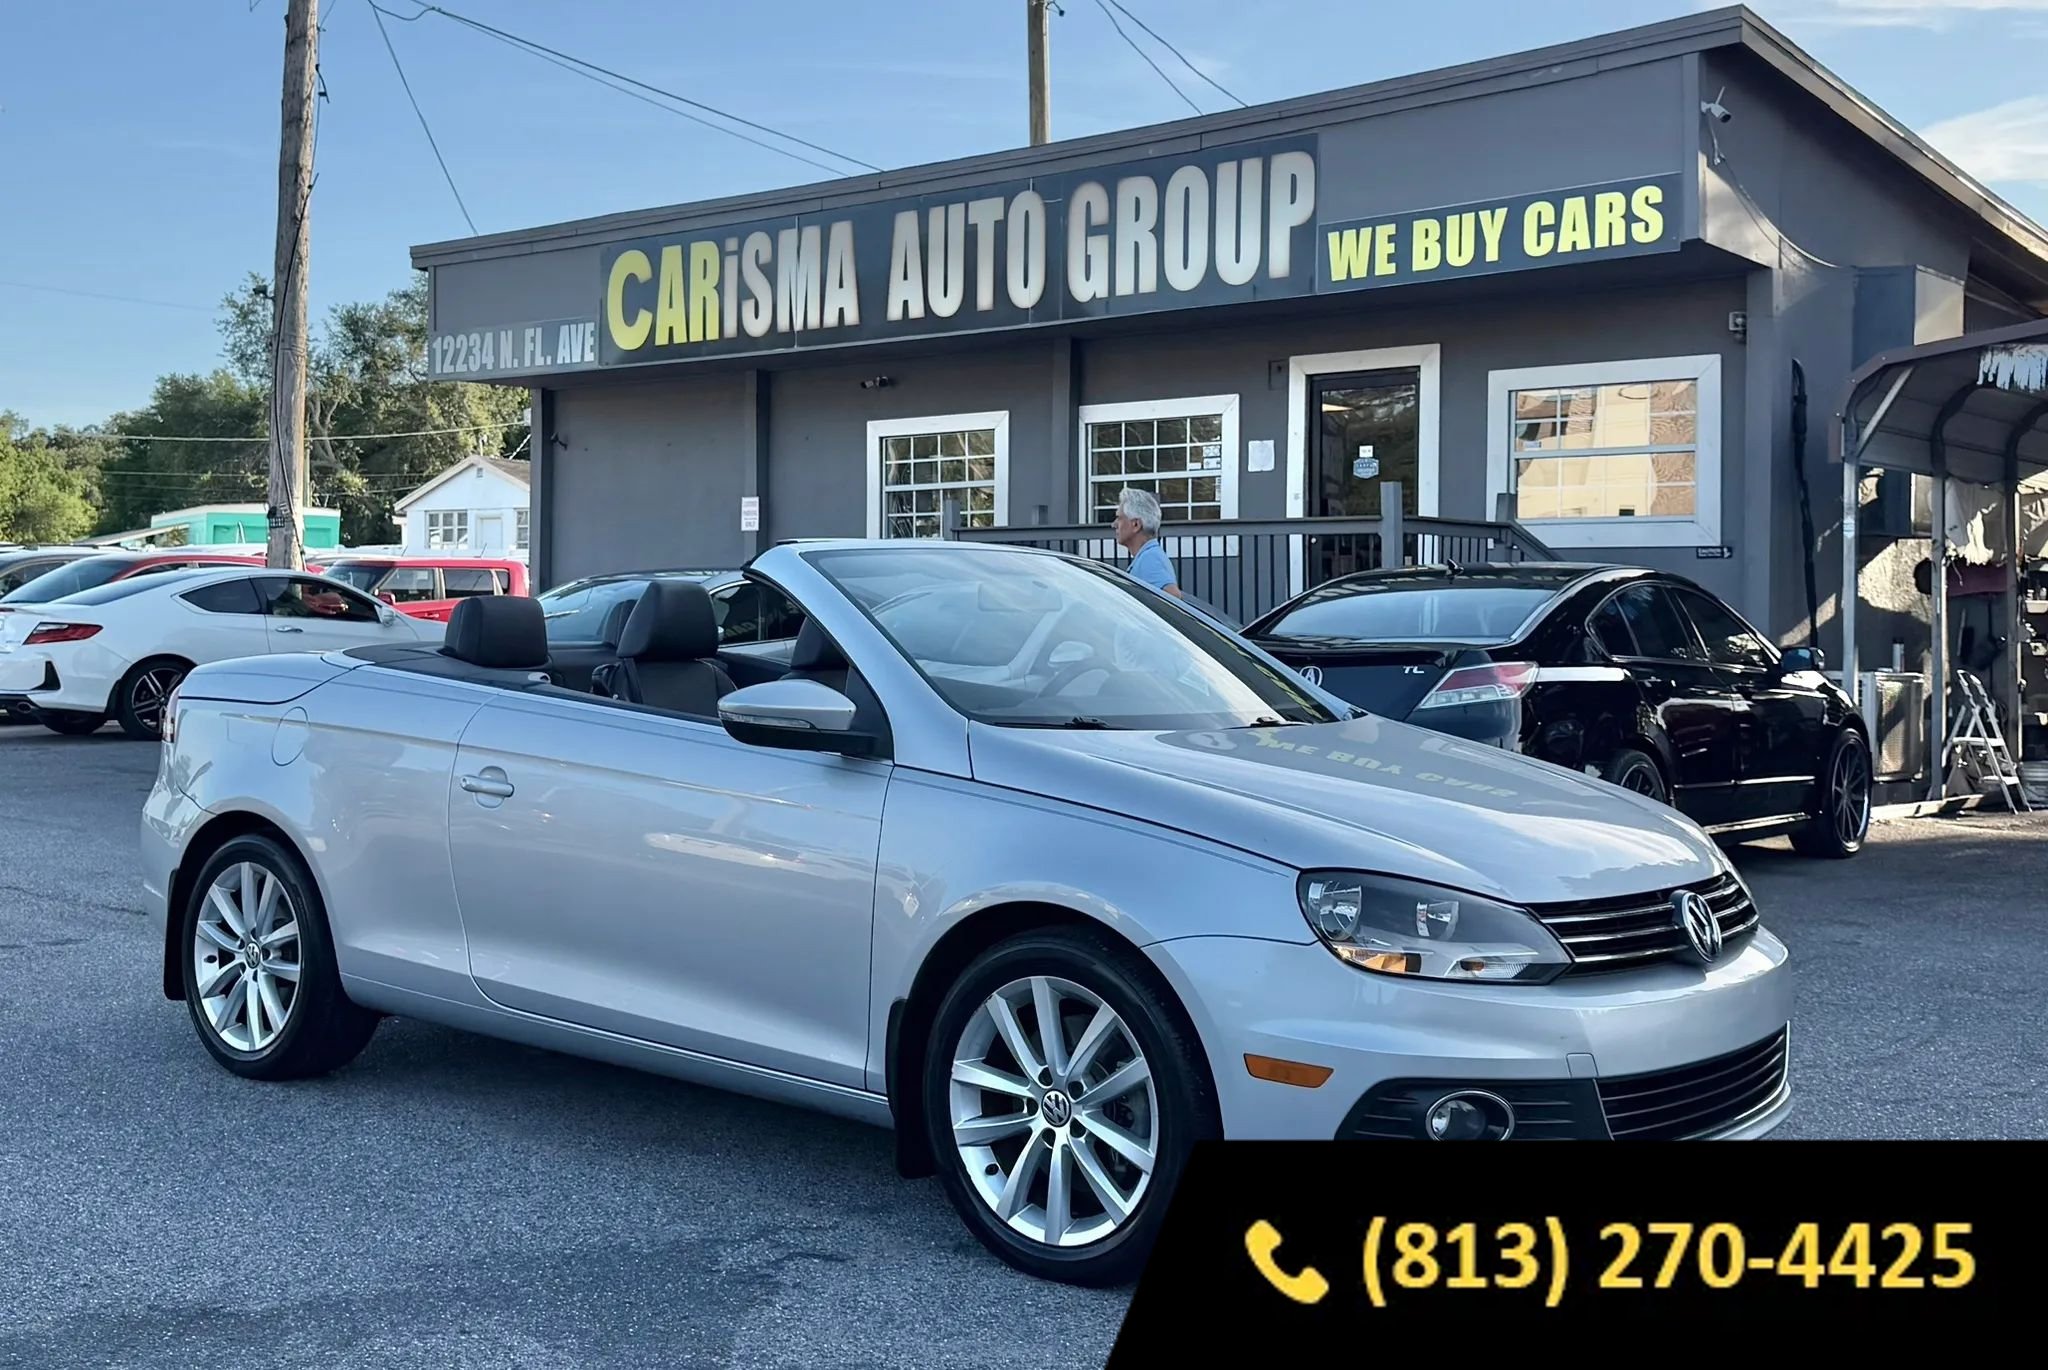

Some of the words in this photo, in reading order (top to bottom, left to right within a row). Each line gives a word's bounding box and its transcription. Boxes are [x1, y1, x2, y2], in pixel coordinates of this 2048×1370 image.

[606, 219, 861, 351] CARiSMA
[887, 190, 1047, 320] AUTO
[1067, 150, 1316, 303] GROUP
[1327, 223, 1397, 282] WE
[1411, 207, 1508, 272] BUY
[1522, 185, 1664, 258] CARS
[432, 331, 495, 374] 12234
[500, 330, 519, 369] N.
[524, 327, 552, 367] FL.
[557, 322, 595, 364] AVE
[1402, 664, 1425, 674] TL
